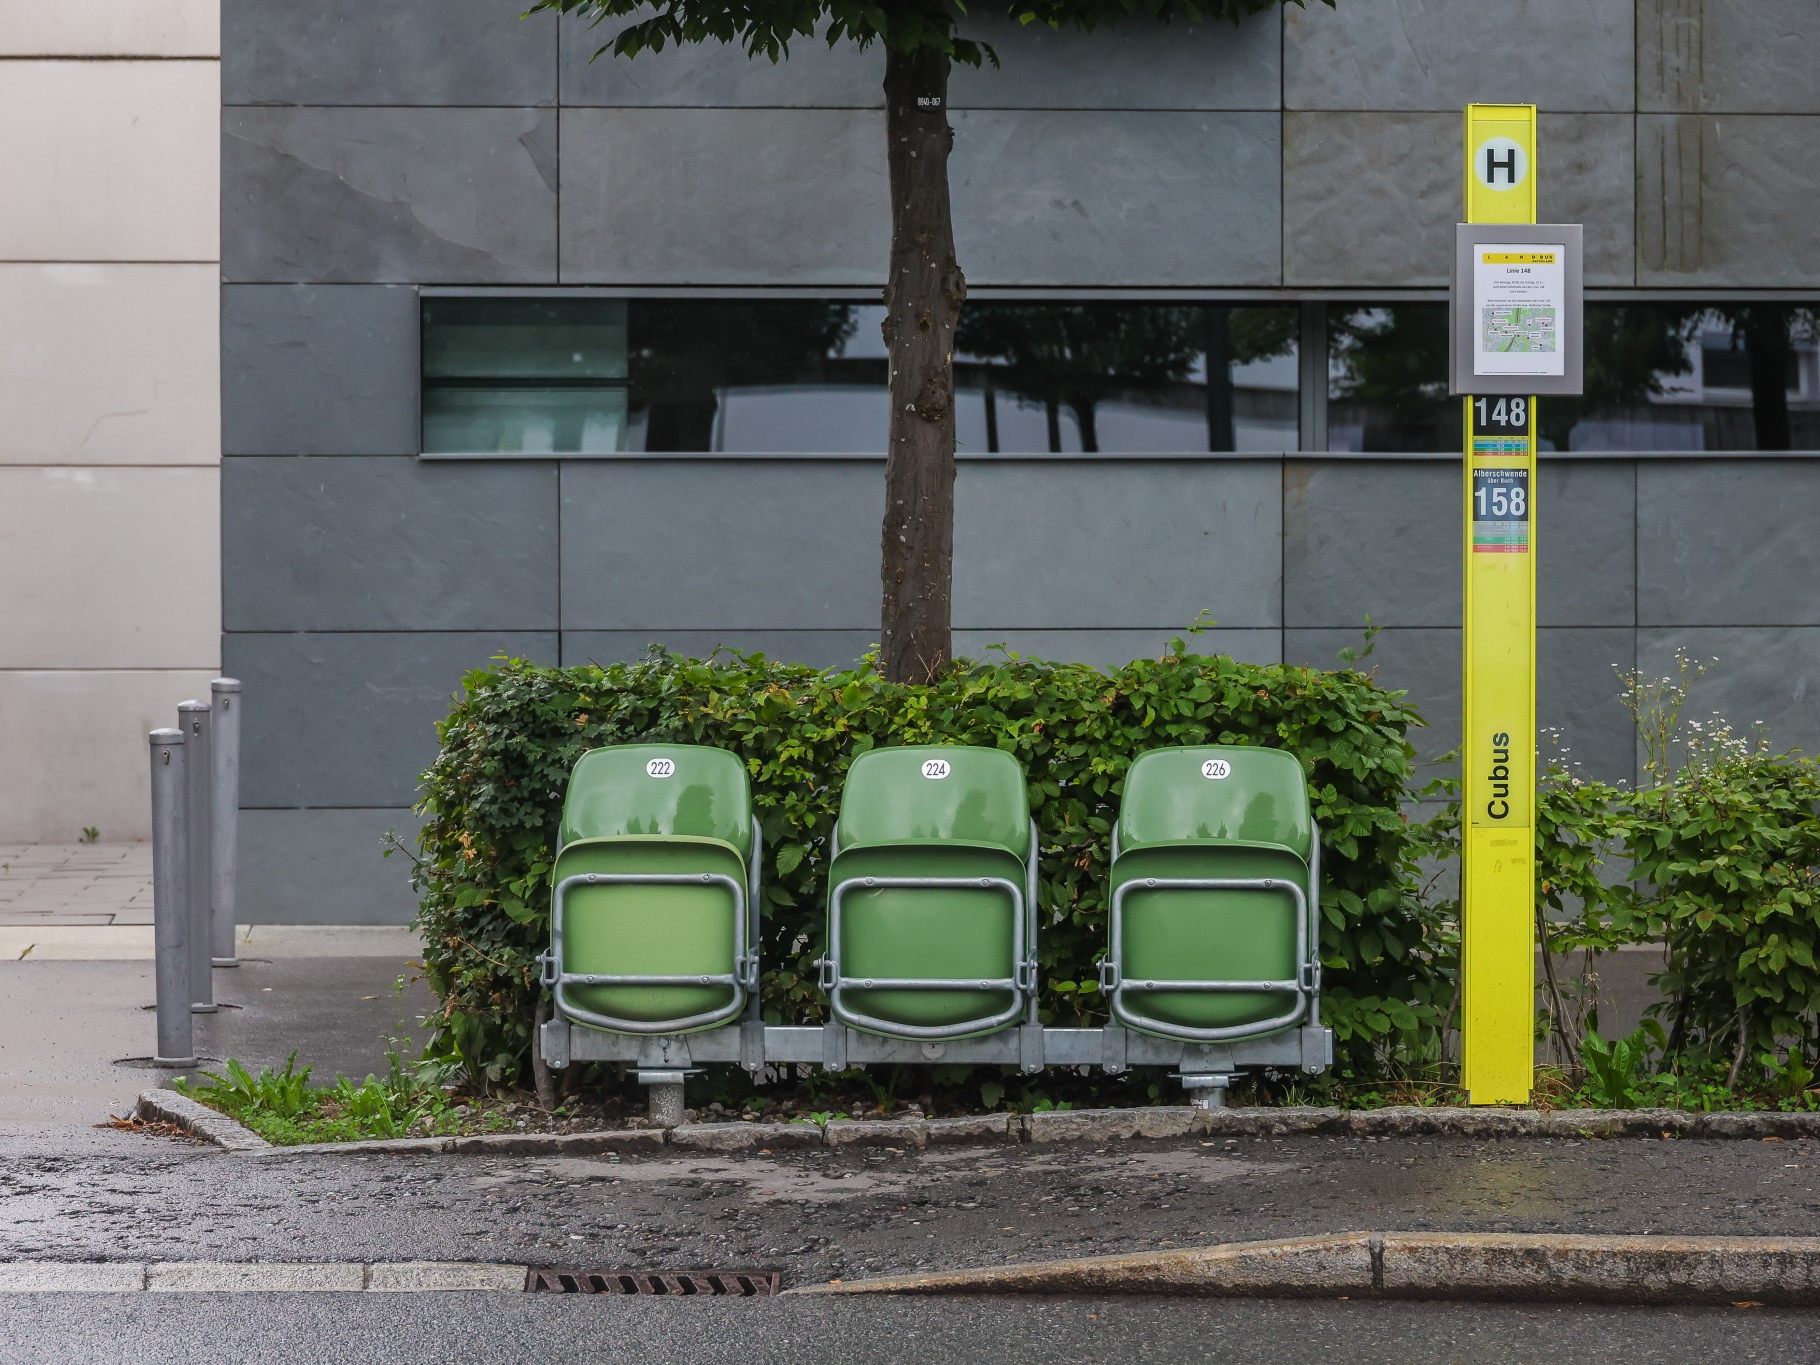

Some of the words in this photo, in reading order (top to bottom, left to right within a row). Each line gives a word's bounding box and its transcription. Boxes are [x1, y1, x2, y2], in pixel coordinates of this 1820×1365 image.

[1486, 148, 1515, 183] H
[1474, 397, 1526, 427] 148
[1473, 469, 1527, 478] Alberschwende
[1474, 487, 1526, 516] 158
[651, 761, 670, 775] 222
[926, 762, 946, 776] 224
[1206, 762, 1226, 776] 226
[1487, 732, 1510, 820] Cubus
